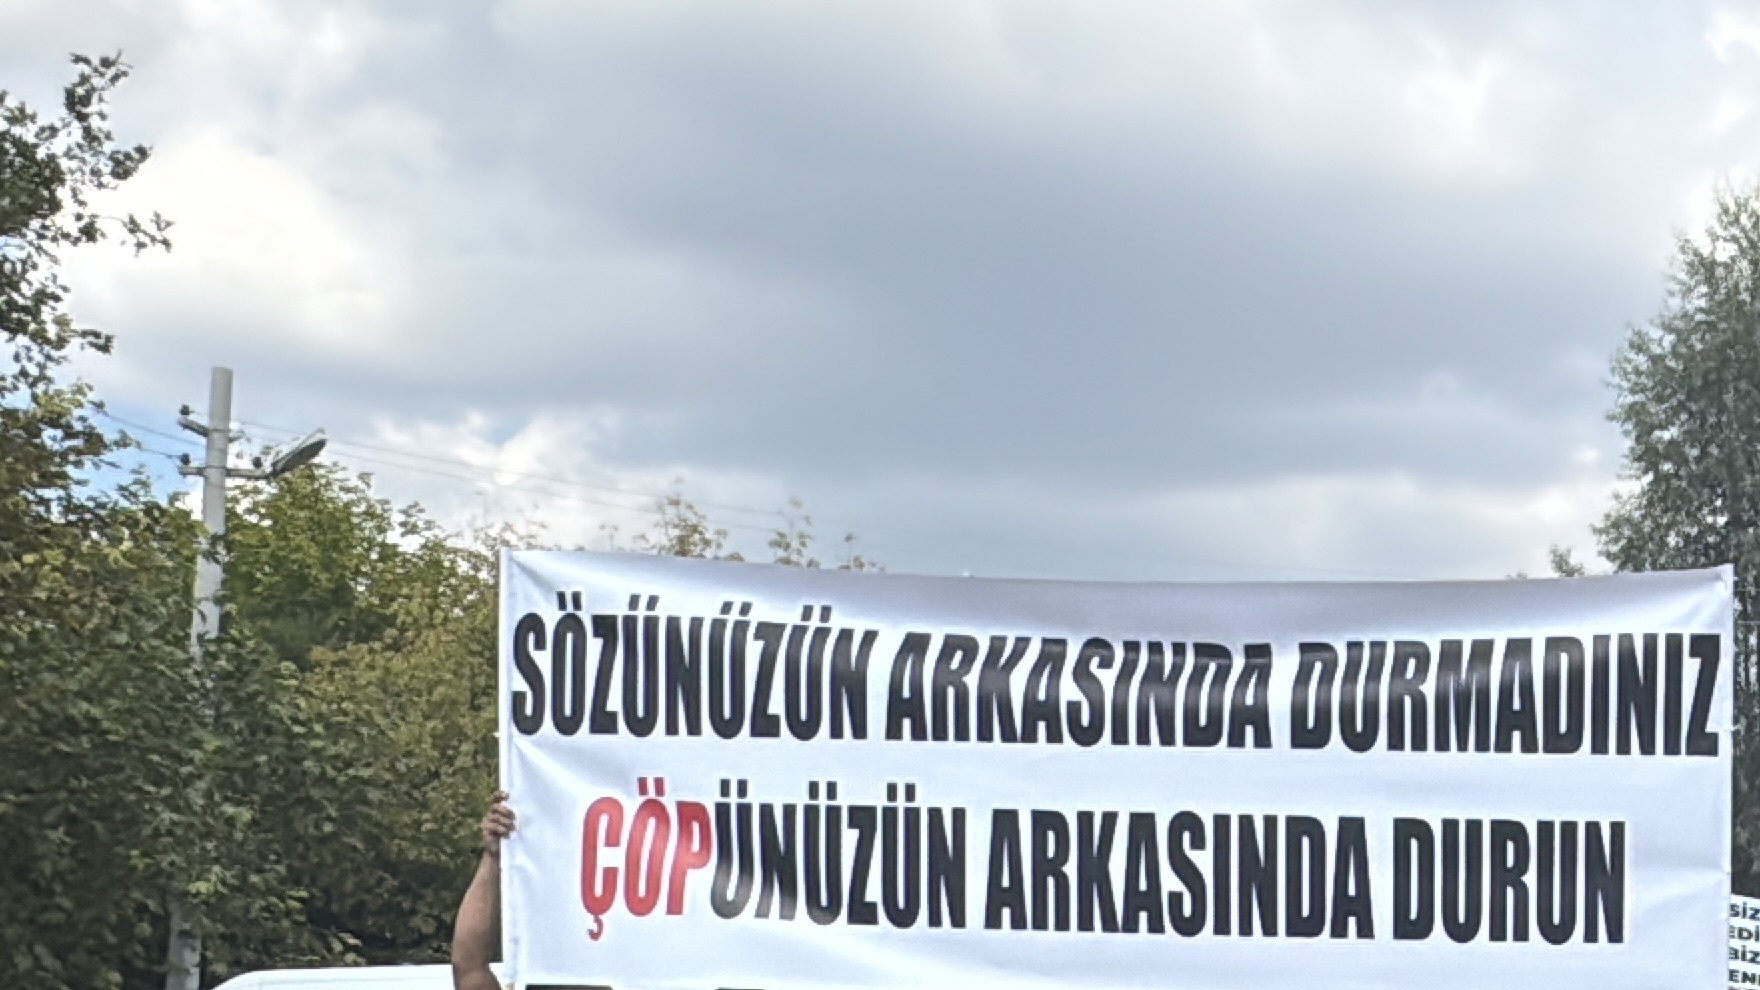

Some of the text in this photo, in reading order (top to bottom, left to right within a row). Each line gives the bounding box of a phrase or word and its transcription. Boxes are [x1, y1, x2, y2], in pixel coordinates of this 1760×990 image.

[511, 591, 1722, 757] SÖZÜNÜZÜN ARKASINDA DURMADINIZ
[580, 777, 1626, 946] ÇÖPÜNÜZÜN ARKASINDA DURUN
